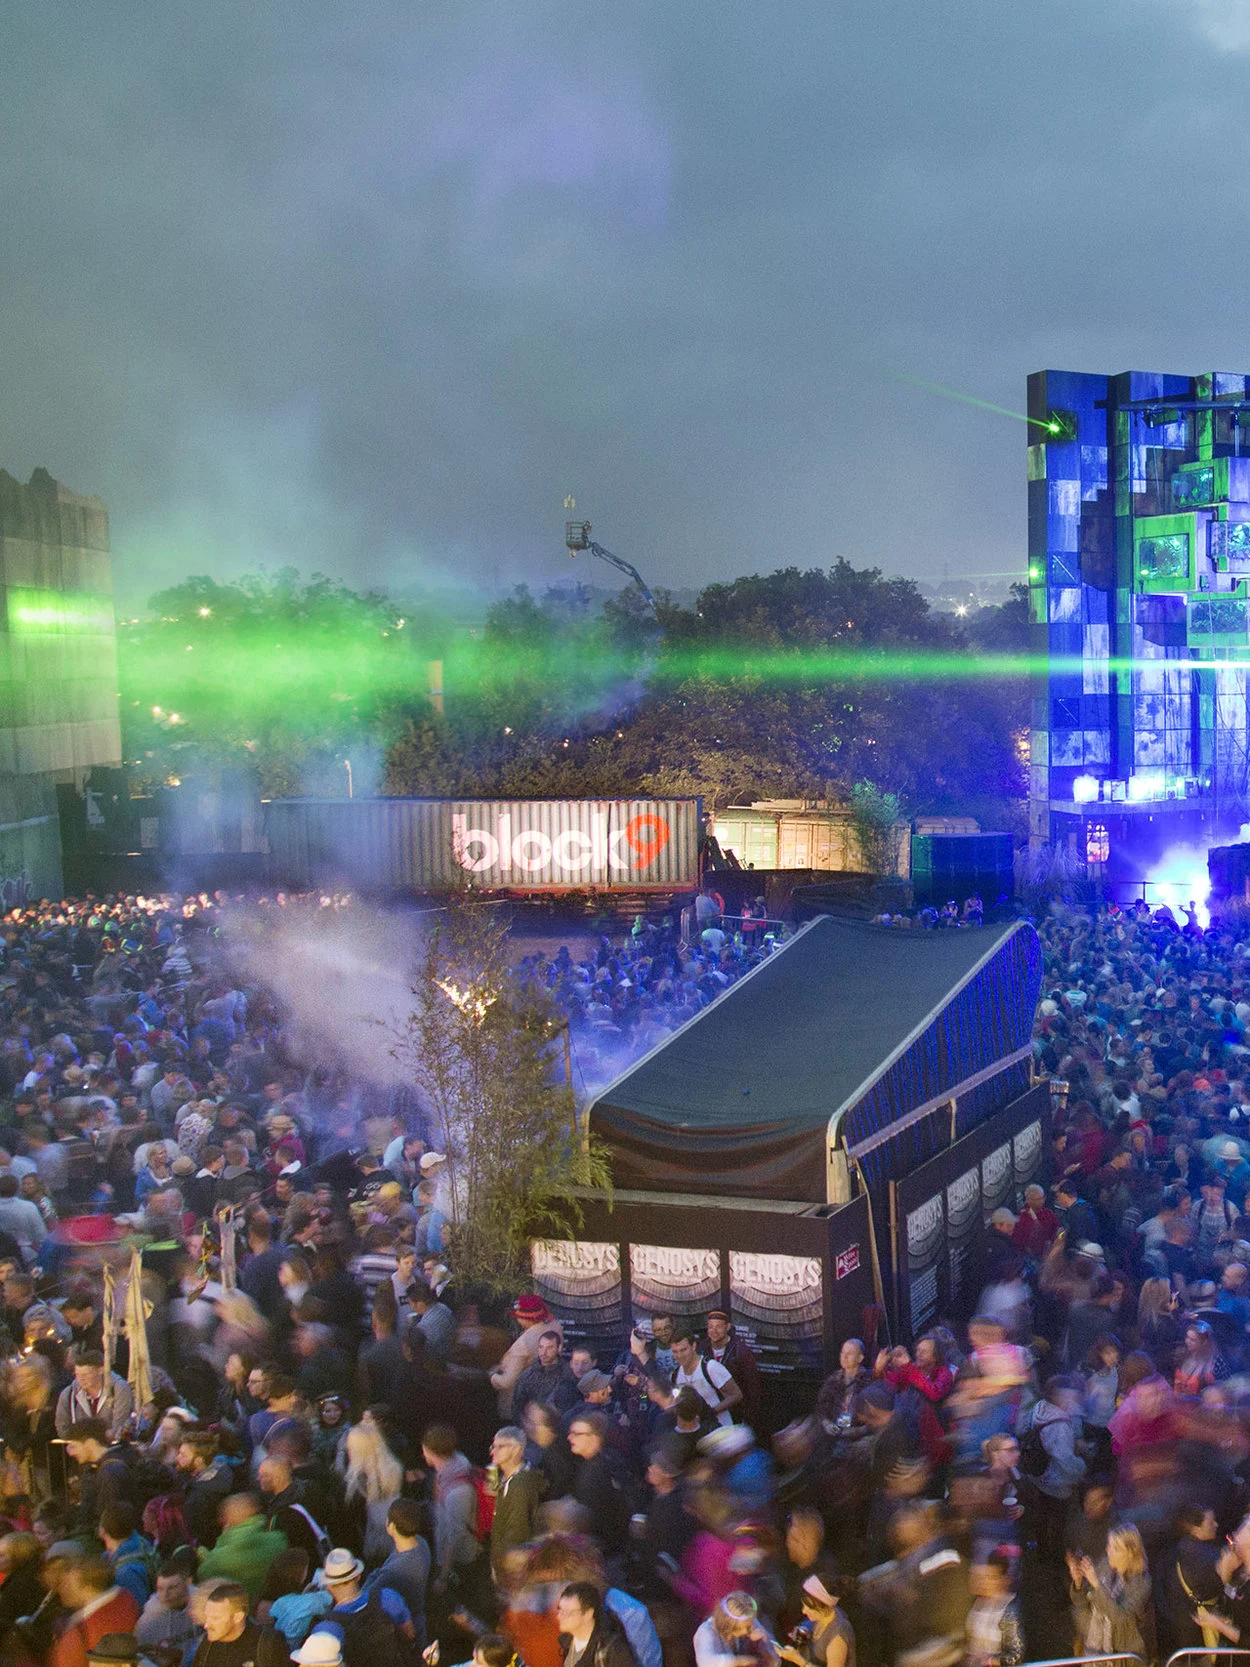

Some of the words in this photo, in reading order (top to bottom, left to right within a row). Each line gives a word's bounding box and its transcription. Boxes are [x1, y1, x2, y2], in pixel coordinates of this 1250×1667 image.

[453, 813, 670, 871] block9
[633, 1246, 719, 1279] GENOSYS
[732, 1255, 821, 1287] GENOSYS
